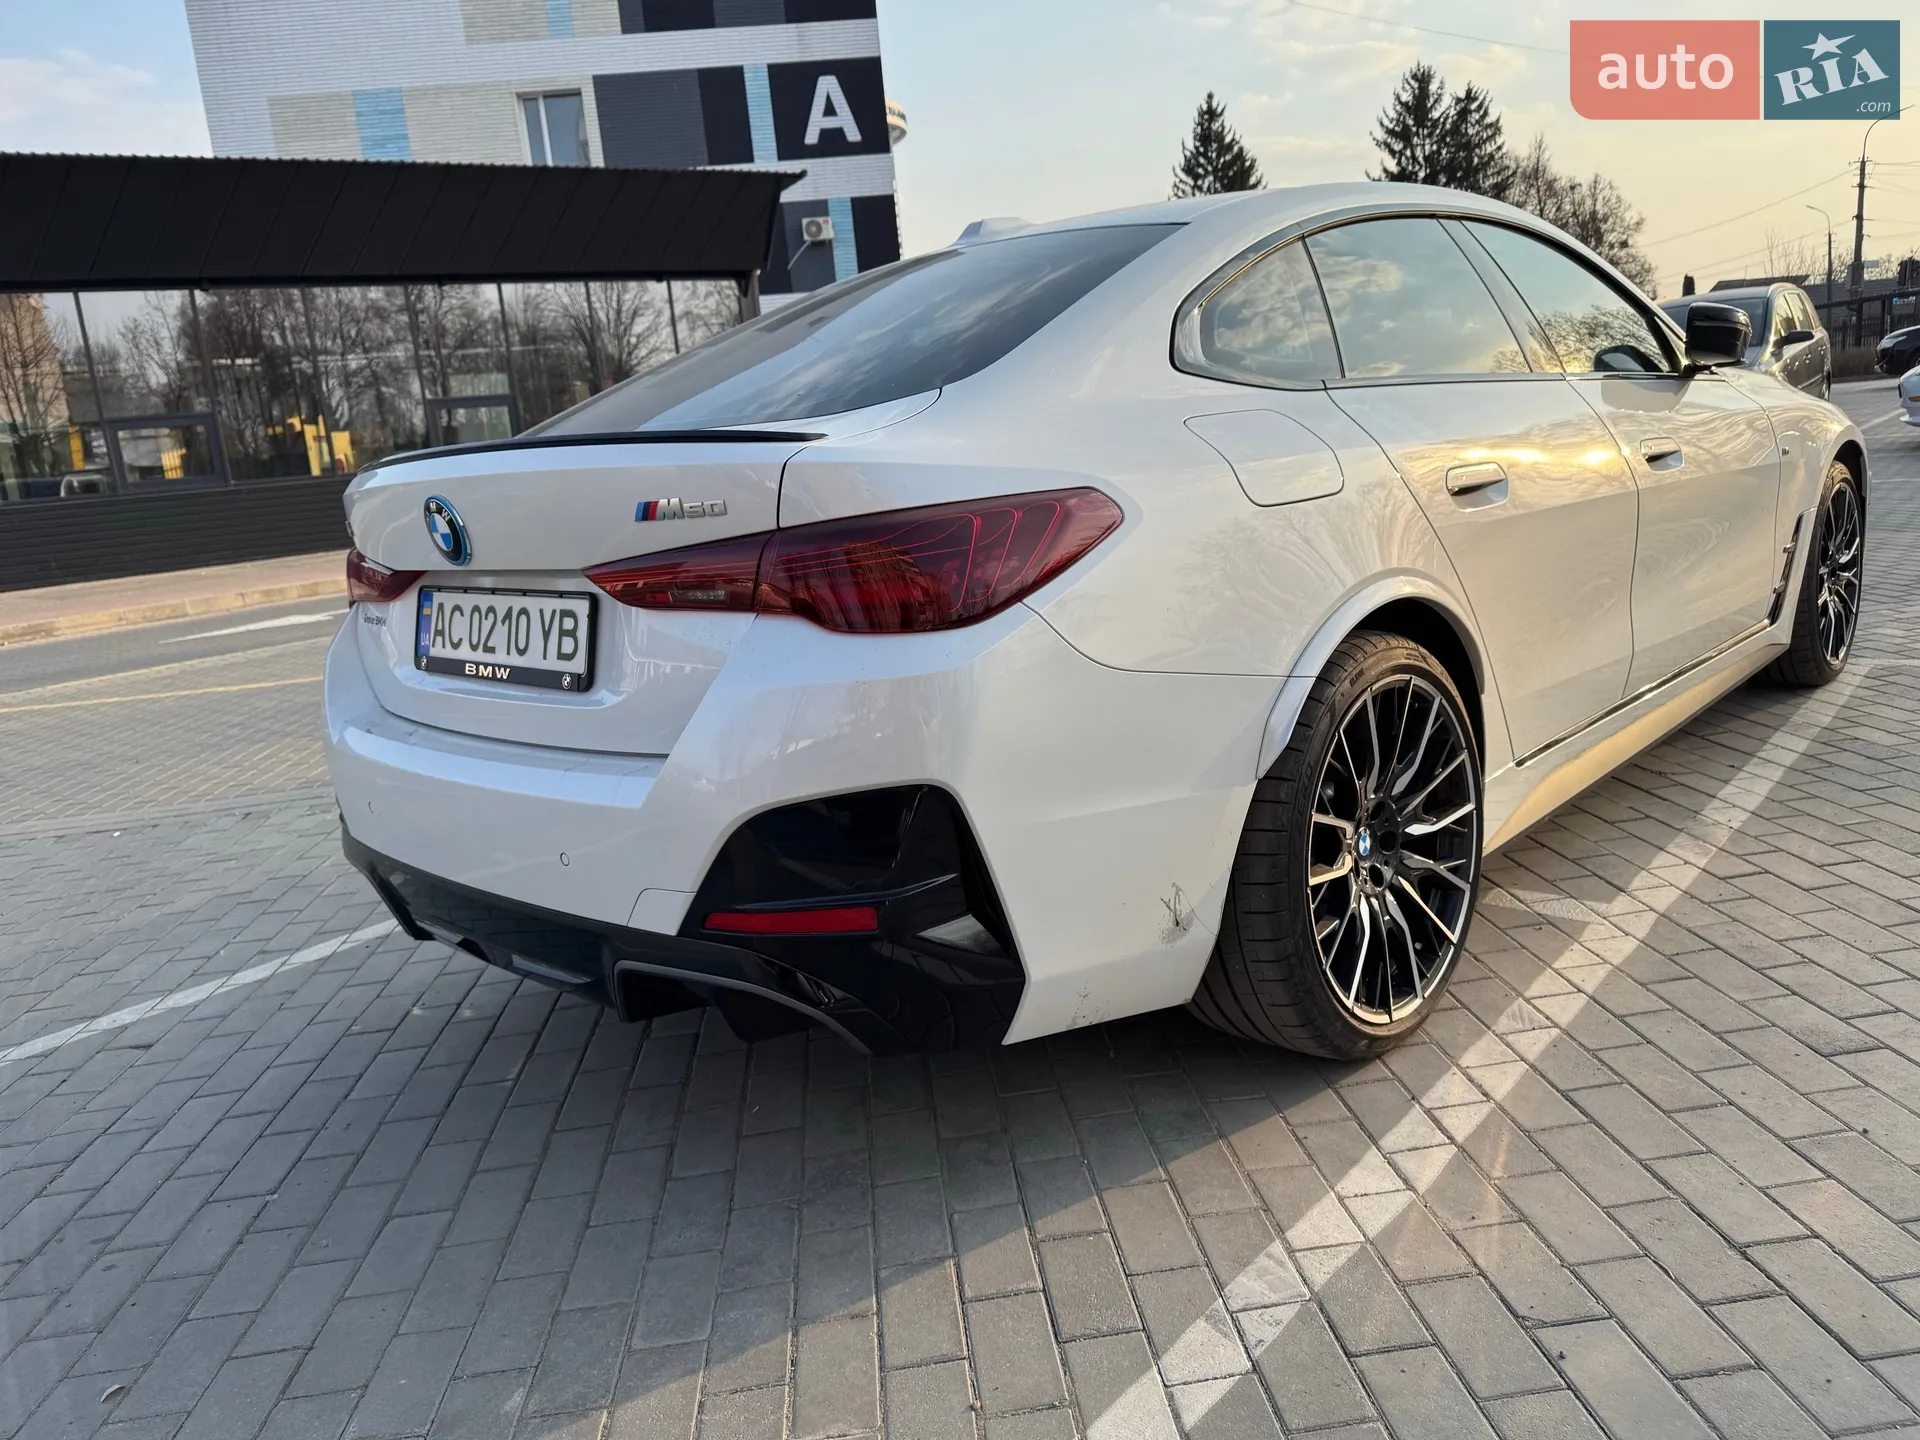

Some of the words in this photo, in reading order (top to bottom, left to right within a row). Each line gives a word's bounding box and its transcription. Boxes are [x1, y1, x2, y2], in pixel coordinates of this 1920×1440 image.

[804, 75, 862, 145] A
[656, 497, 727, 520] M50
[420, 632, 431, 646] UA
[432, 602, 465, 650] AC
[468, 604, 531, 657] 0210
[539, 608, 579, 662] YB
[465, 662, 510, 680] BMW
